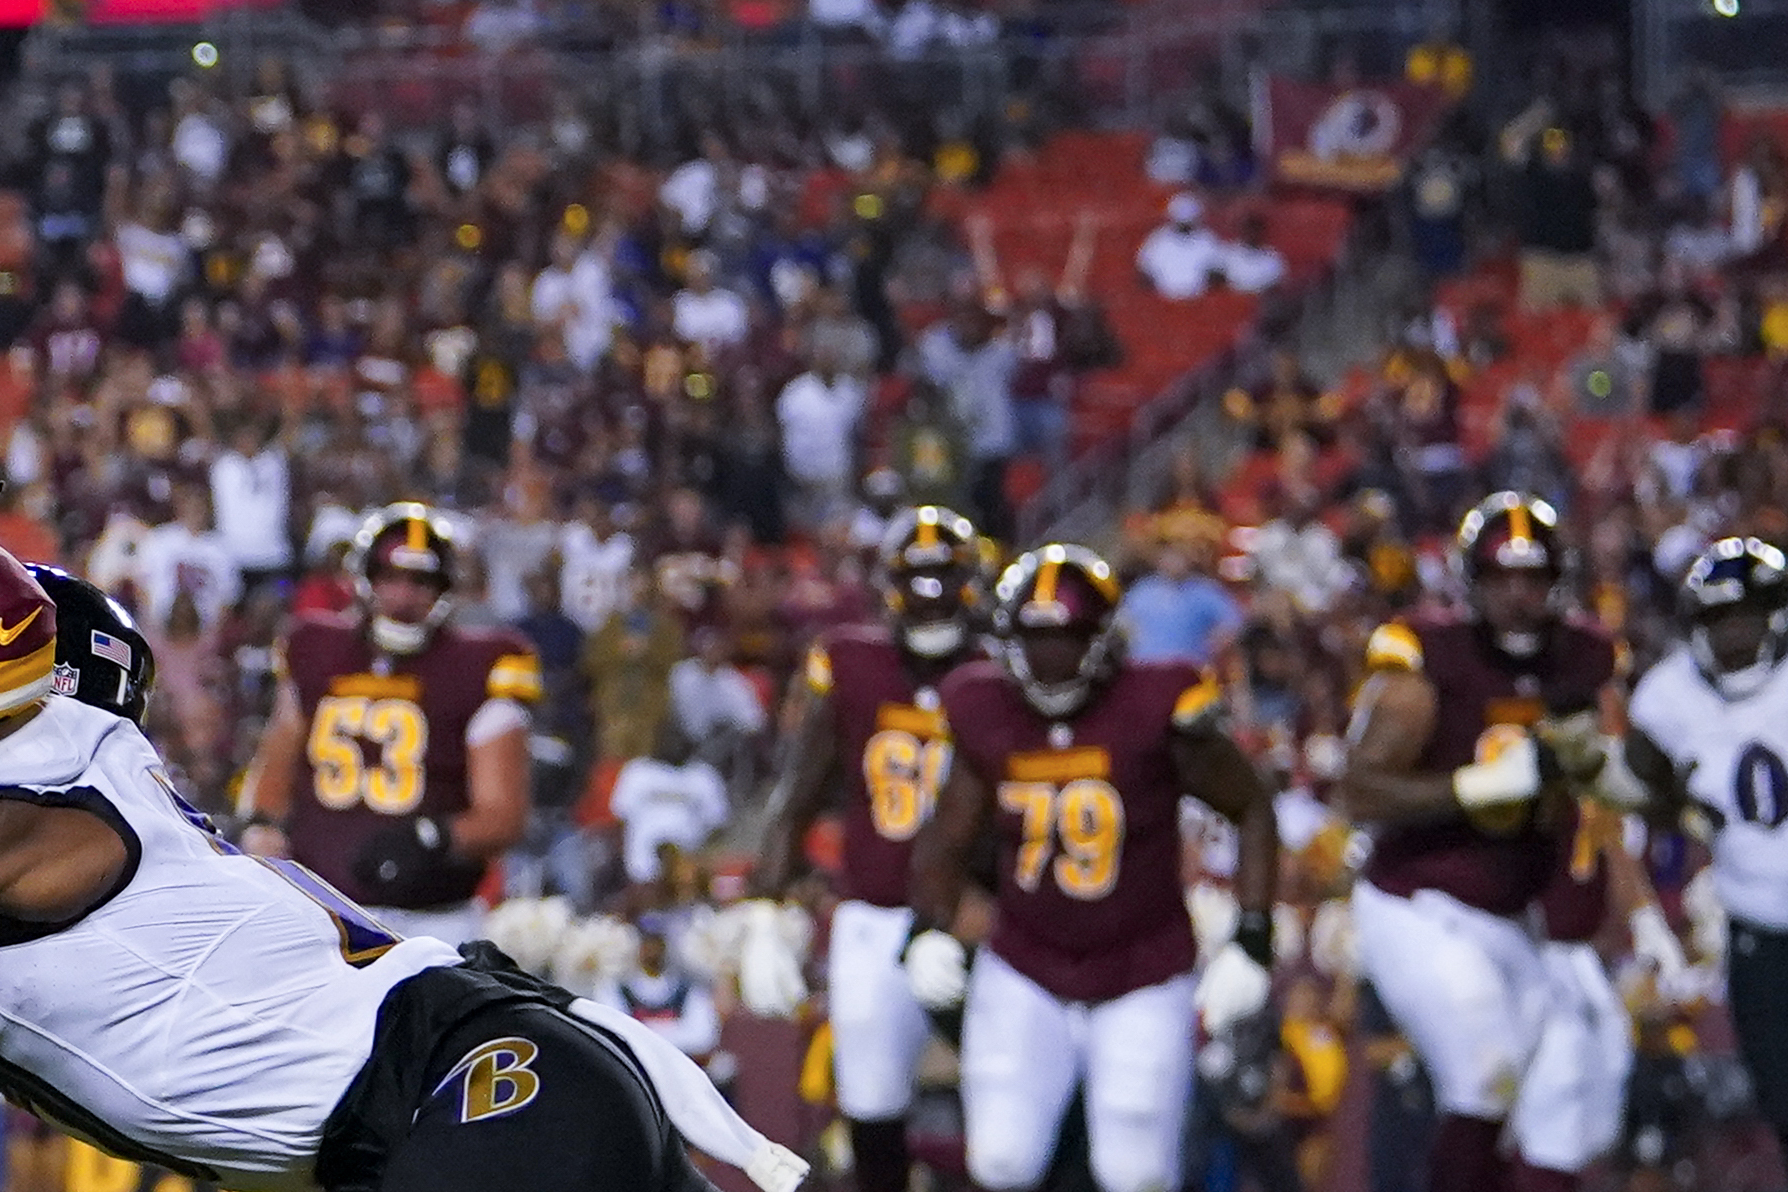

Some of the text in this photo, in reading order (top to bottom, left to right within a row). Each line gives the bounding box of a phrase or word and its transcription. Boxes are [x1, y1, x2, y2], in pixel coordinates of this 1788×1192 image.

[308, 695, 429, 815] 53
[1732, 742, 1788, 828] 0
[997, 778, 1126, 900] 79
[431, 1036, 540, 1123] B
